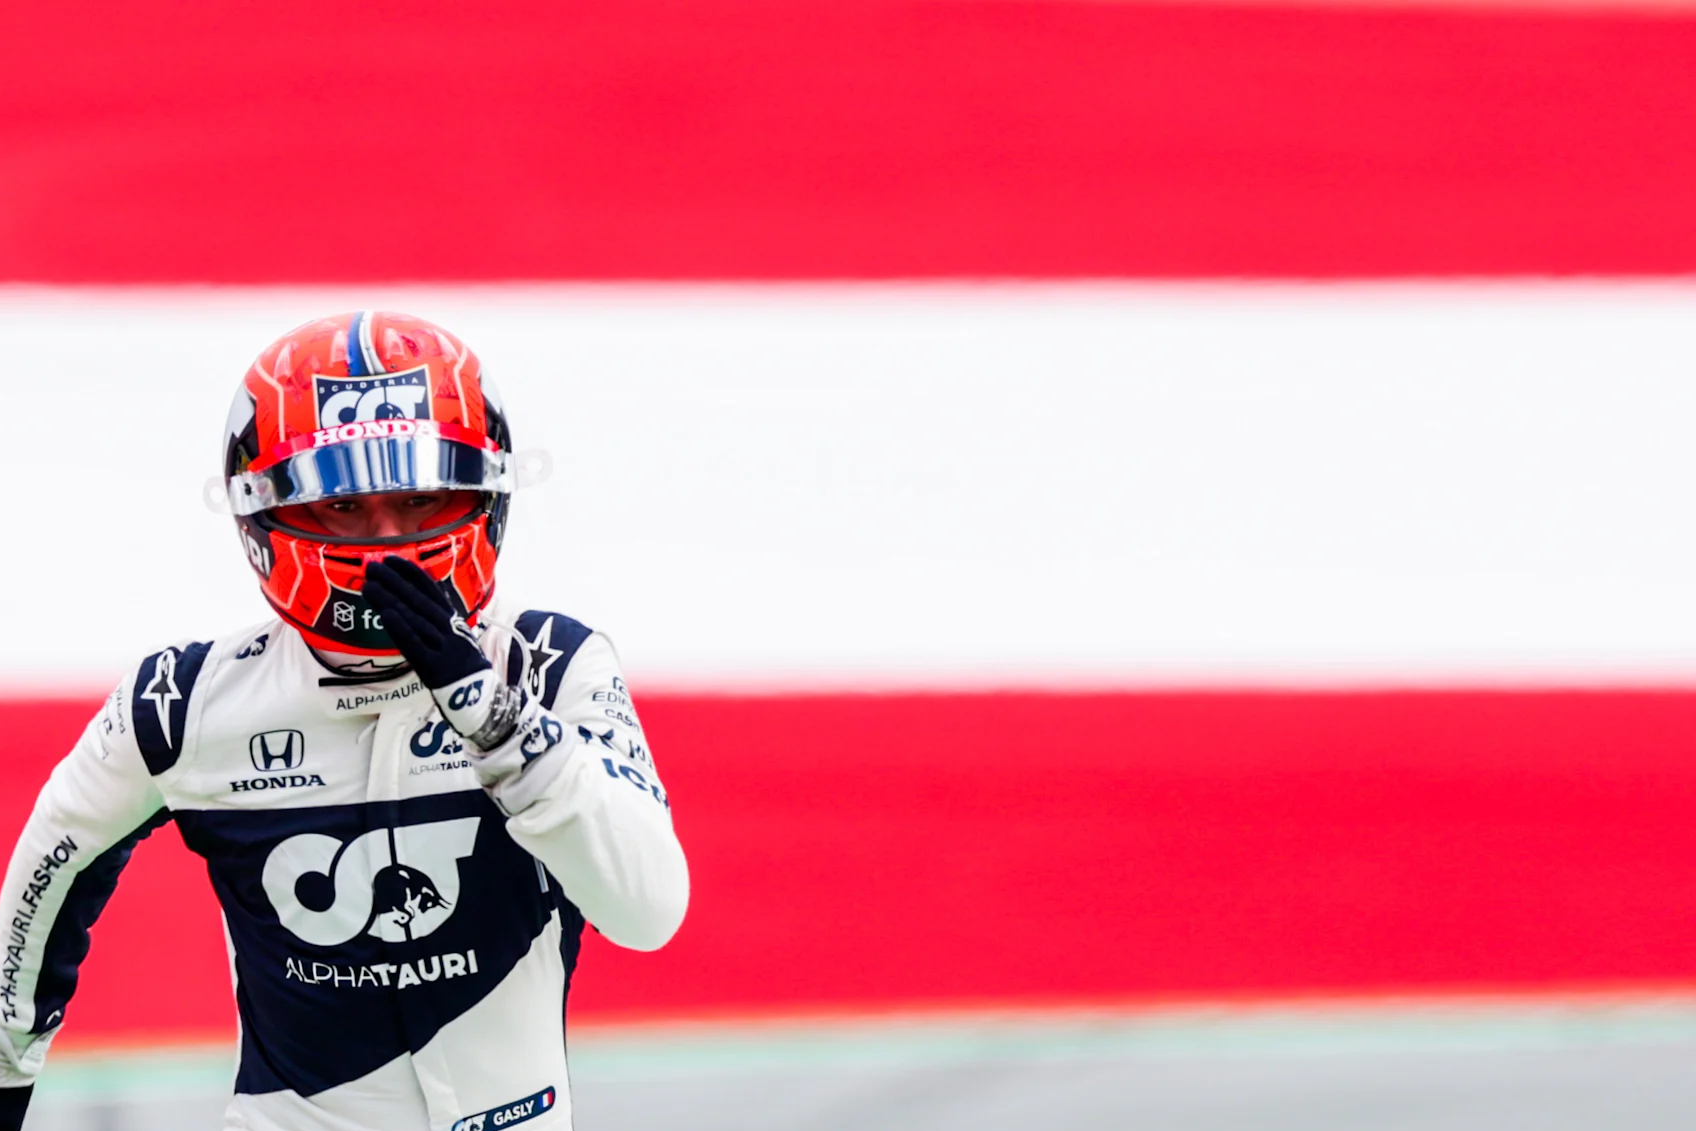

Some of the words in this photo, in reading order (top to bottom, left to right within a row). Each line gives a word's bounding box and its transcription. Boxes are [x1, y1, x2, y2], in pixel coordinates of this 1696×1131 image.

[318, 377, 419, 394] SCUDERIA
[312, 419, 442, 448] HONDA
[229, 774, 327, 793] HONDA
[285, 948, 480, 990] ALPHATAURI
[493, 1100, 535, 1127] GASLY
